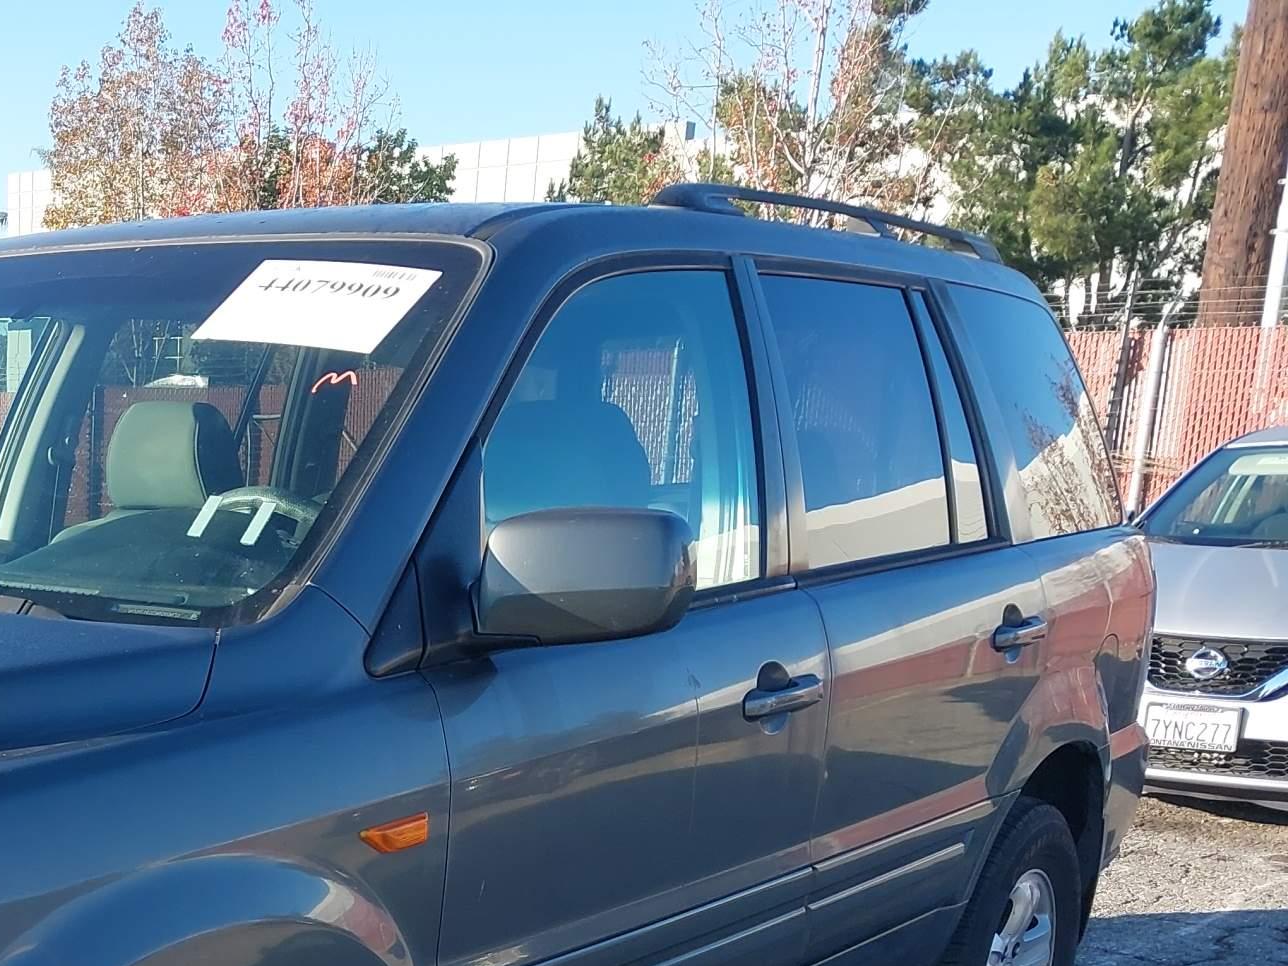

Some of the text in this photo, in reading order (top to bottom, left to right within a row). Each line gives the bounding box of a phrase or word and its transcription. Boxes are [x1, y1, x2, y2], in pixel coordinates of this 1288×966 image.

[258, 277, 401, 299] 44079909
[1151, 718, 1232, 744] 7YNC277
[1186, 741, 1233, 751] NISSAN
